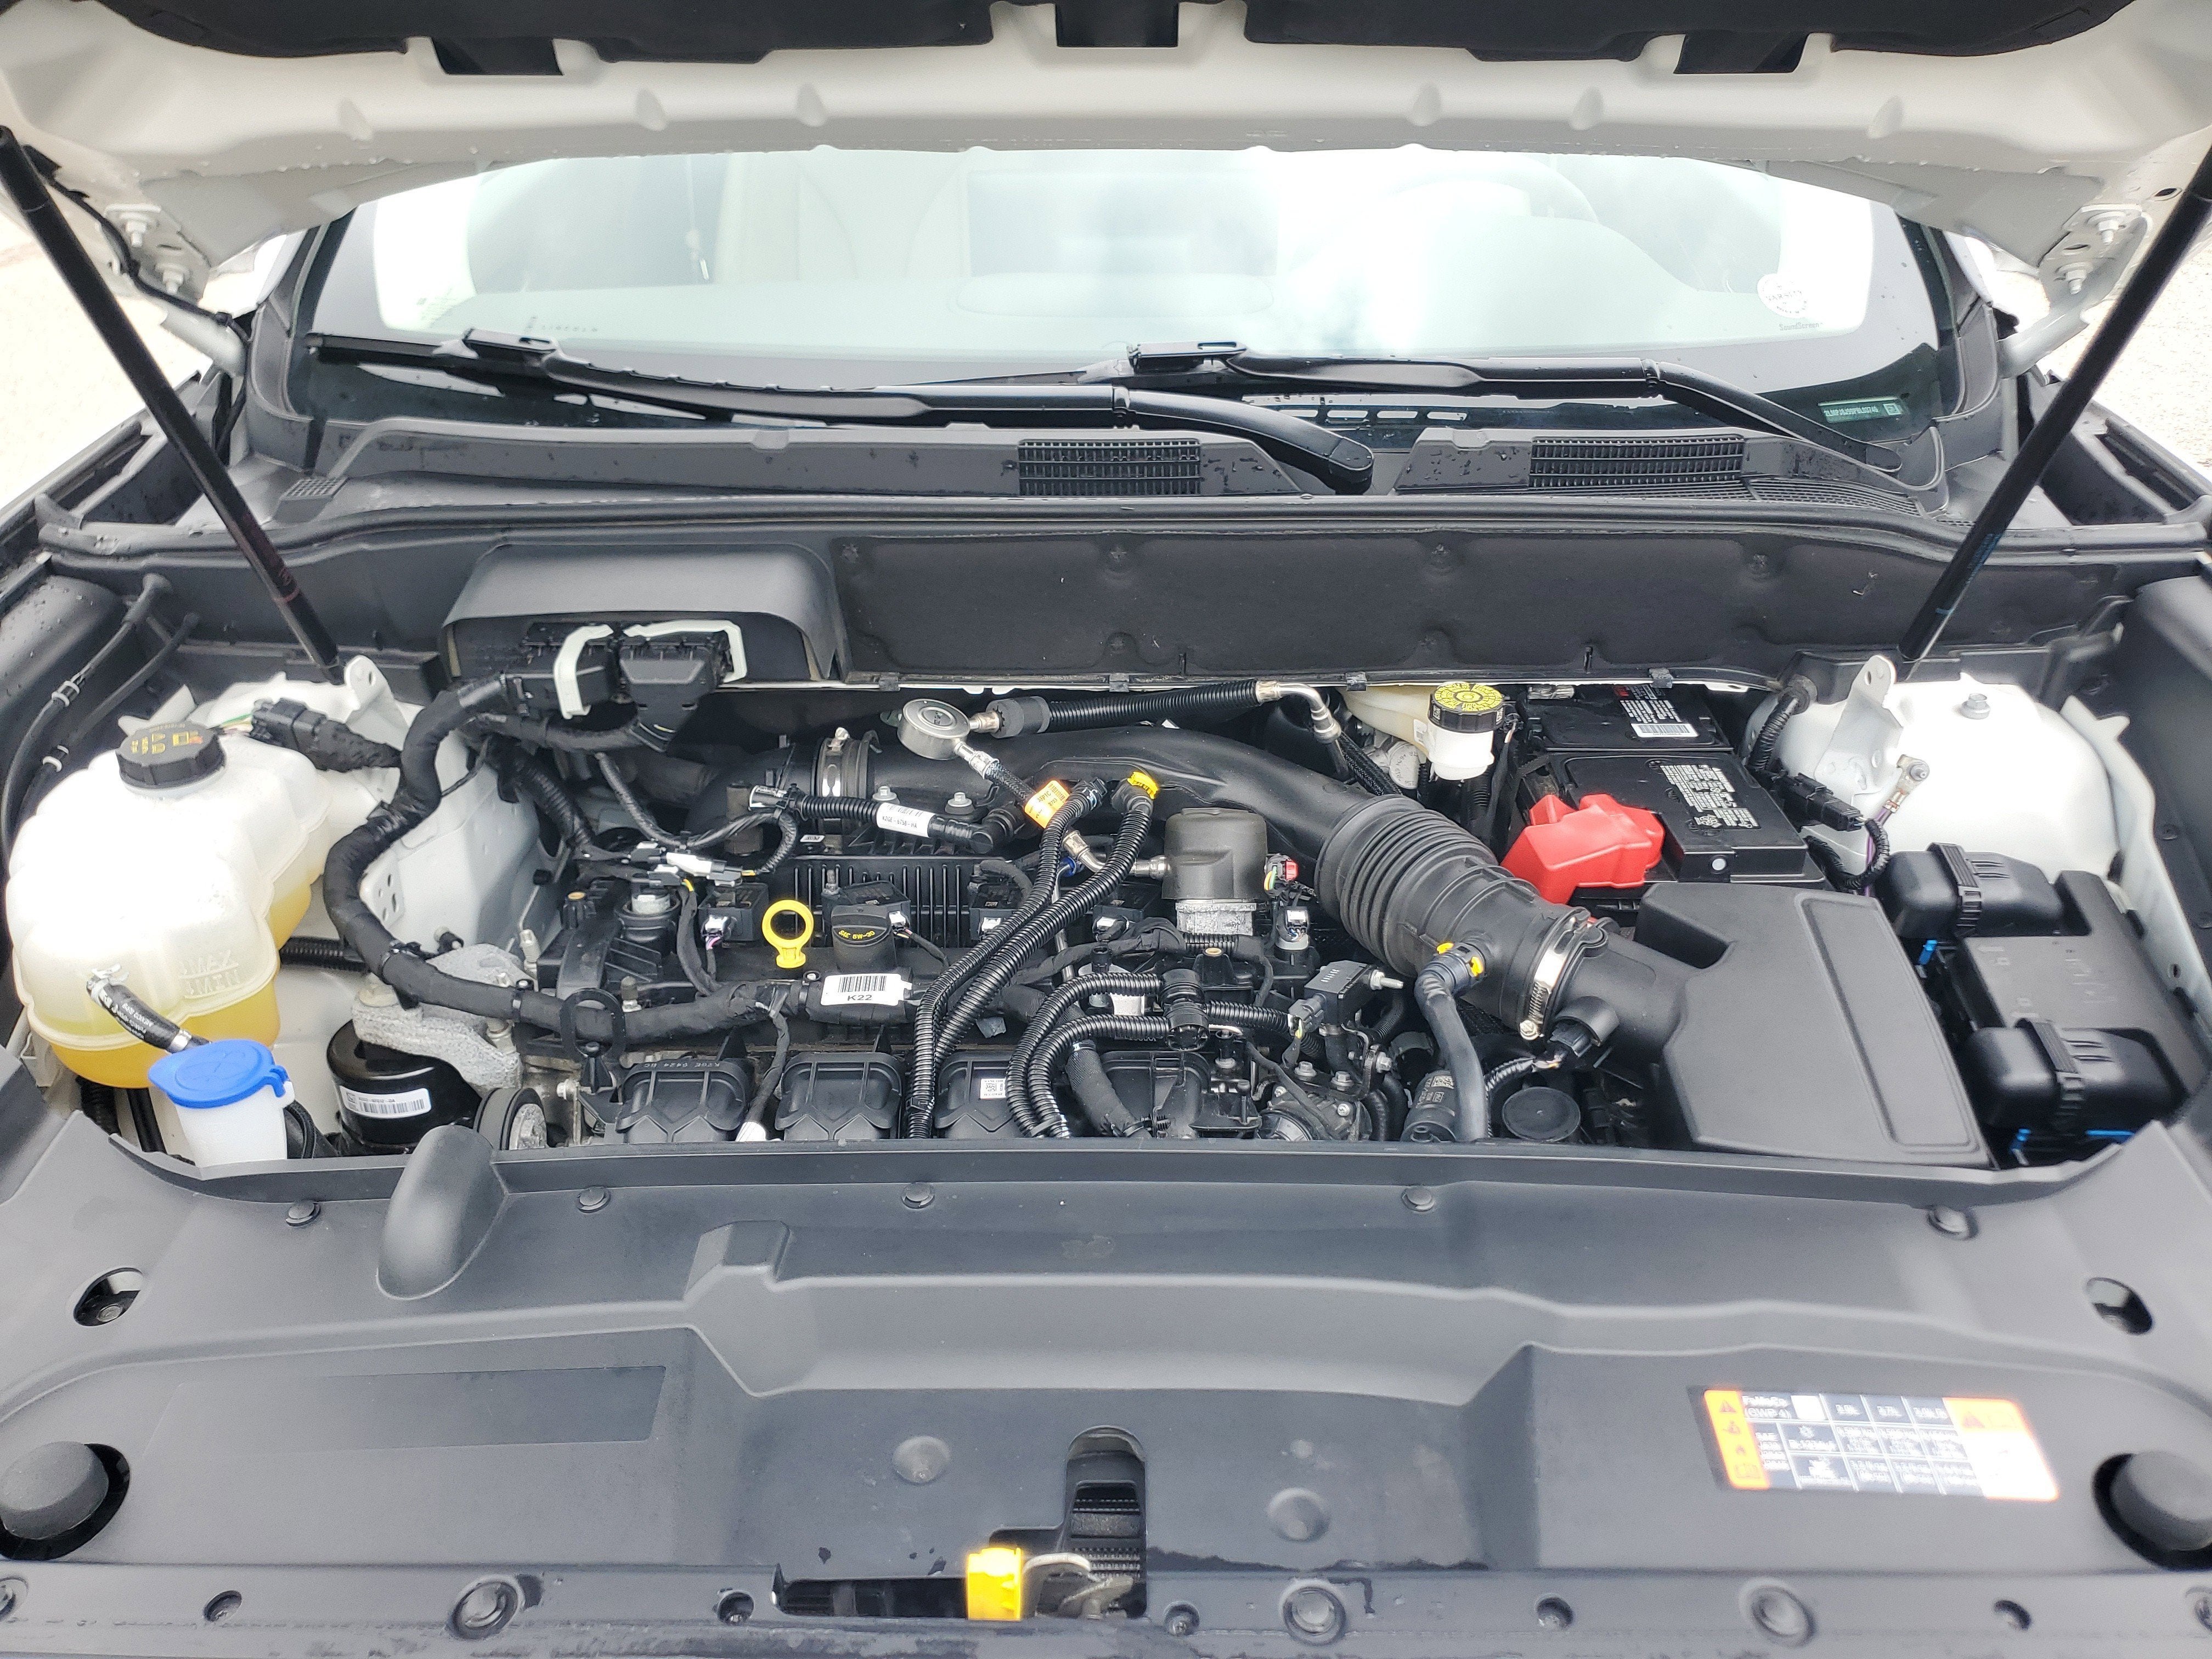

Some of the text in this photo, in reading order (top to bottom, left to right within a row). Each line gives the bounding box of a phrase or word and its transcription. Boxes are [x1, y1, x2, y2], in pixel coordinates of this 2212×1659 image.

[1779, 322, 1820, 330] SoundScreen
[838, 930, 876, 939] SAE 5W-30
